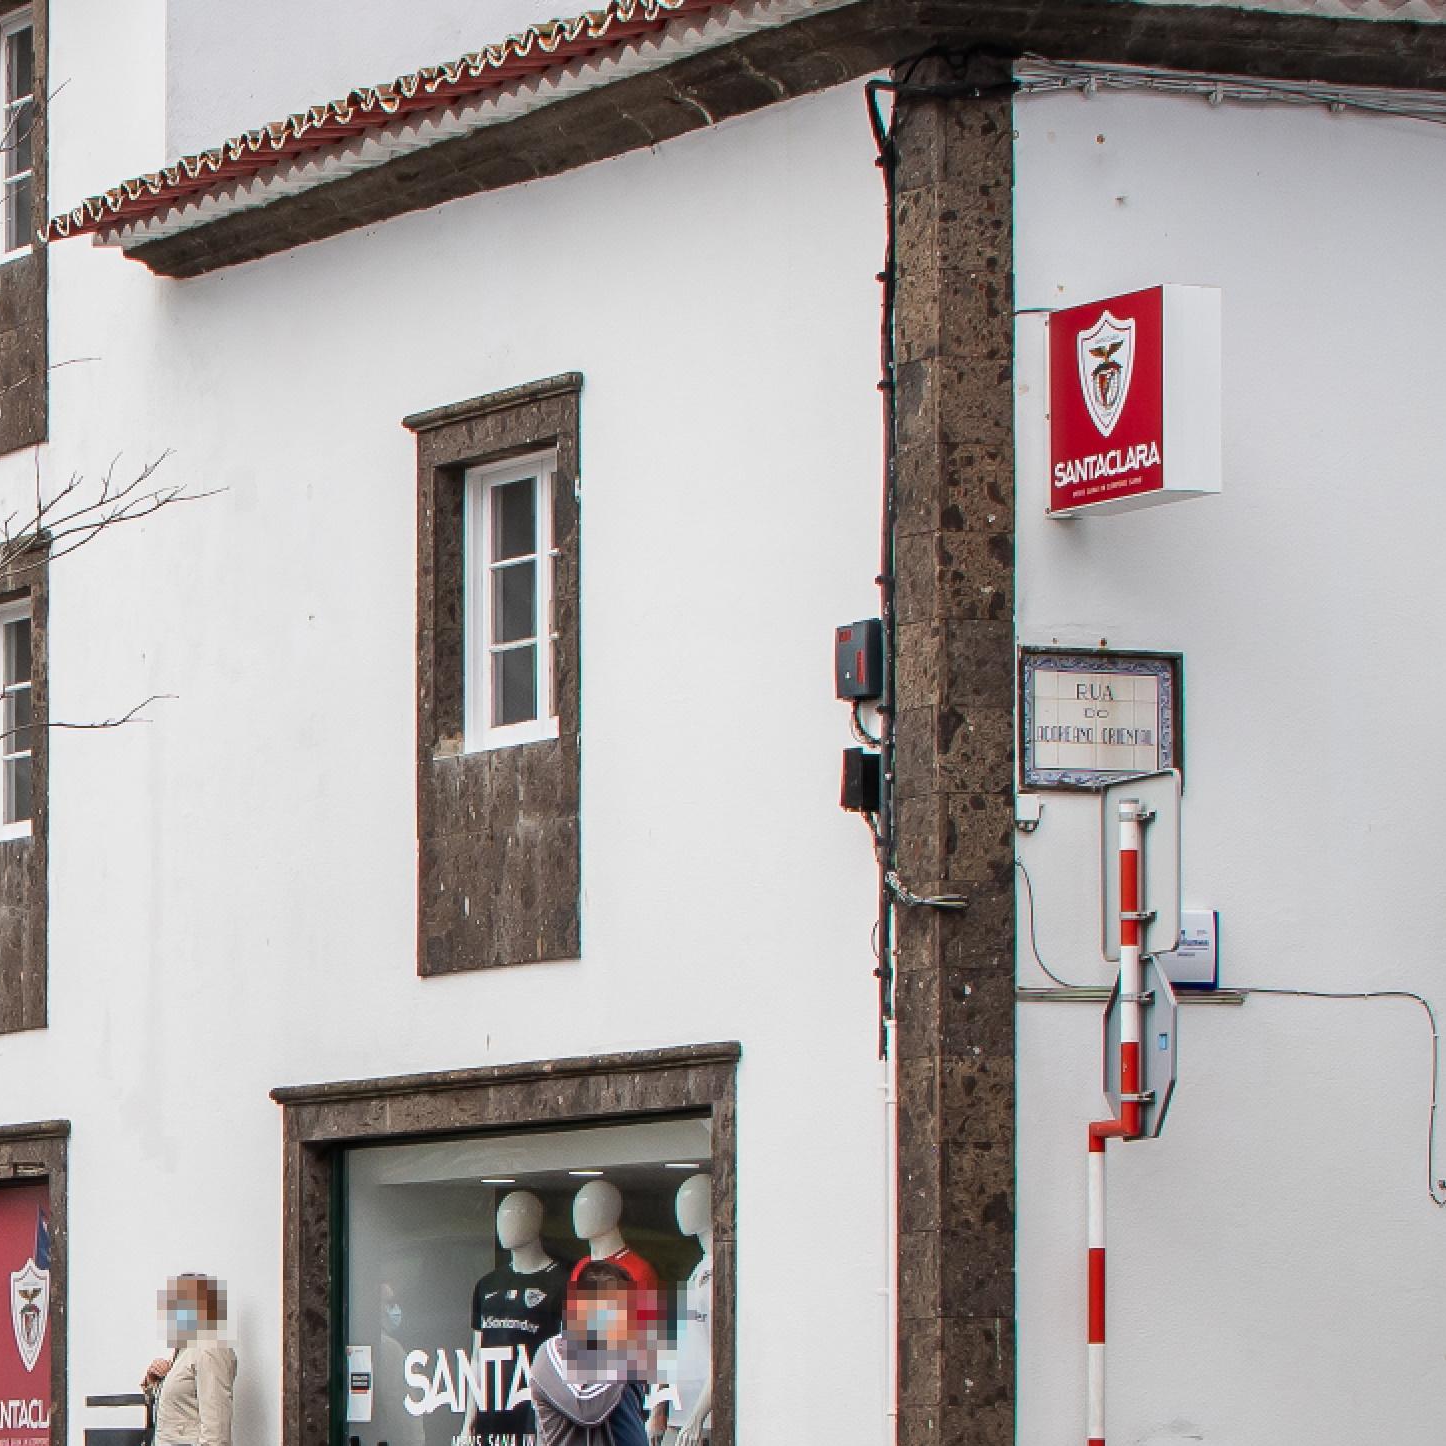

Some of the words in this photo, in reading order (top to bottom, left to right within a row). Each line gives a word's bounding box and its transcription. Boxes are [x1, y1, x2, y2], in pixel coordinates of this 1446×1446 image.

[1054, 441, 1161, 488] SANTACLARA
[1076, 683, 1114, 700] RUA
[1084, 708, 1110, 719] DO
